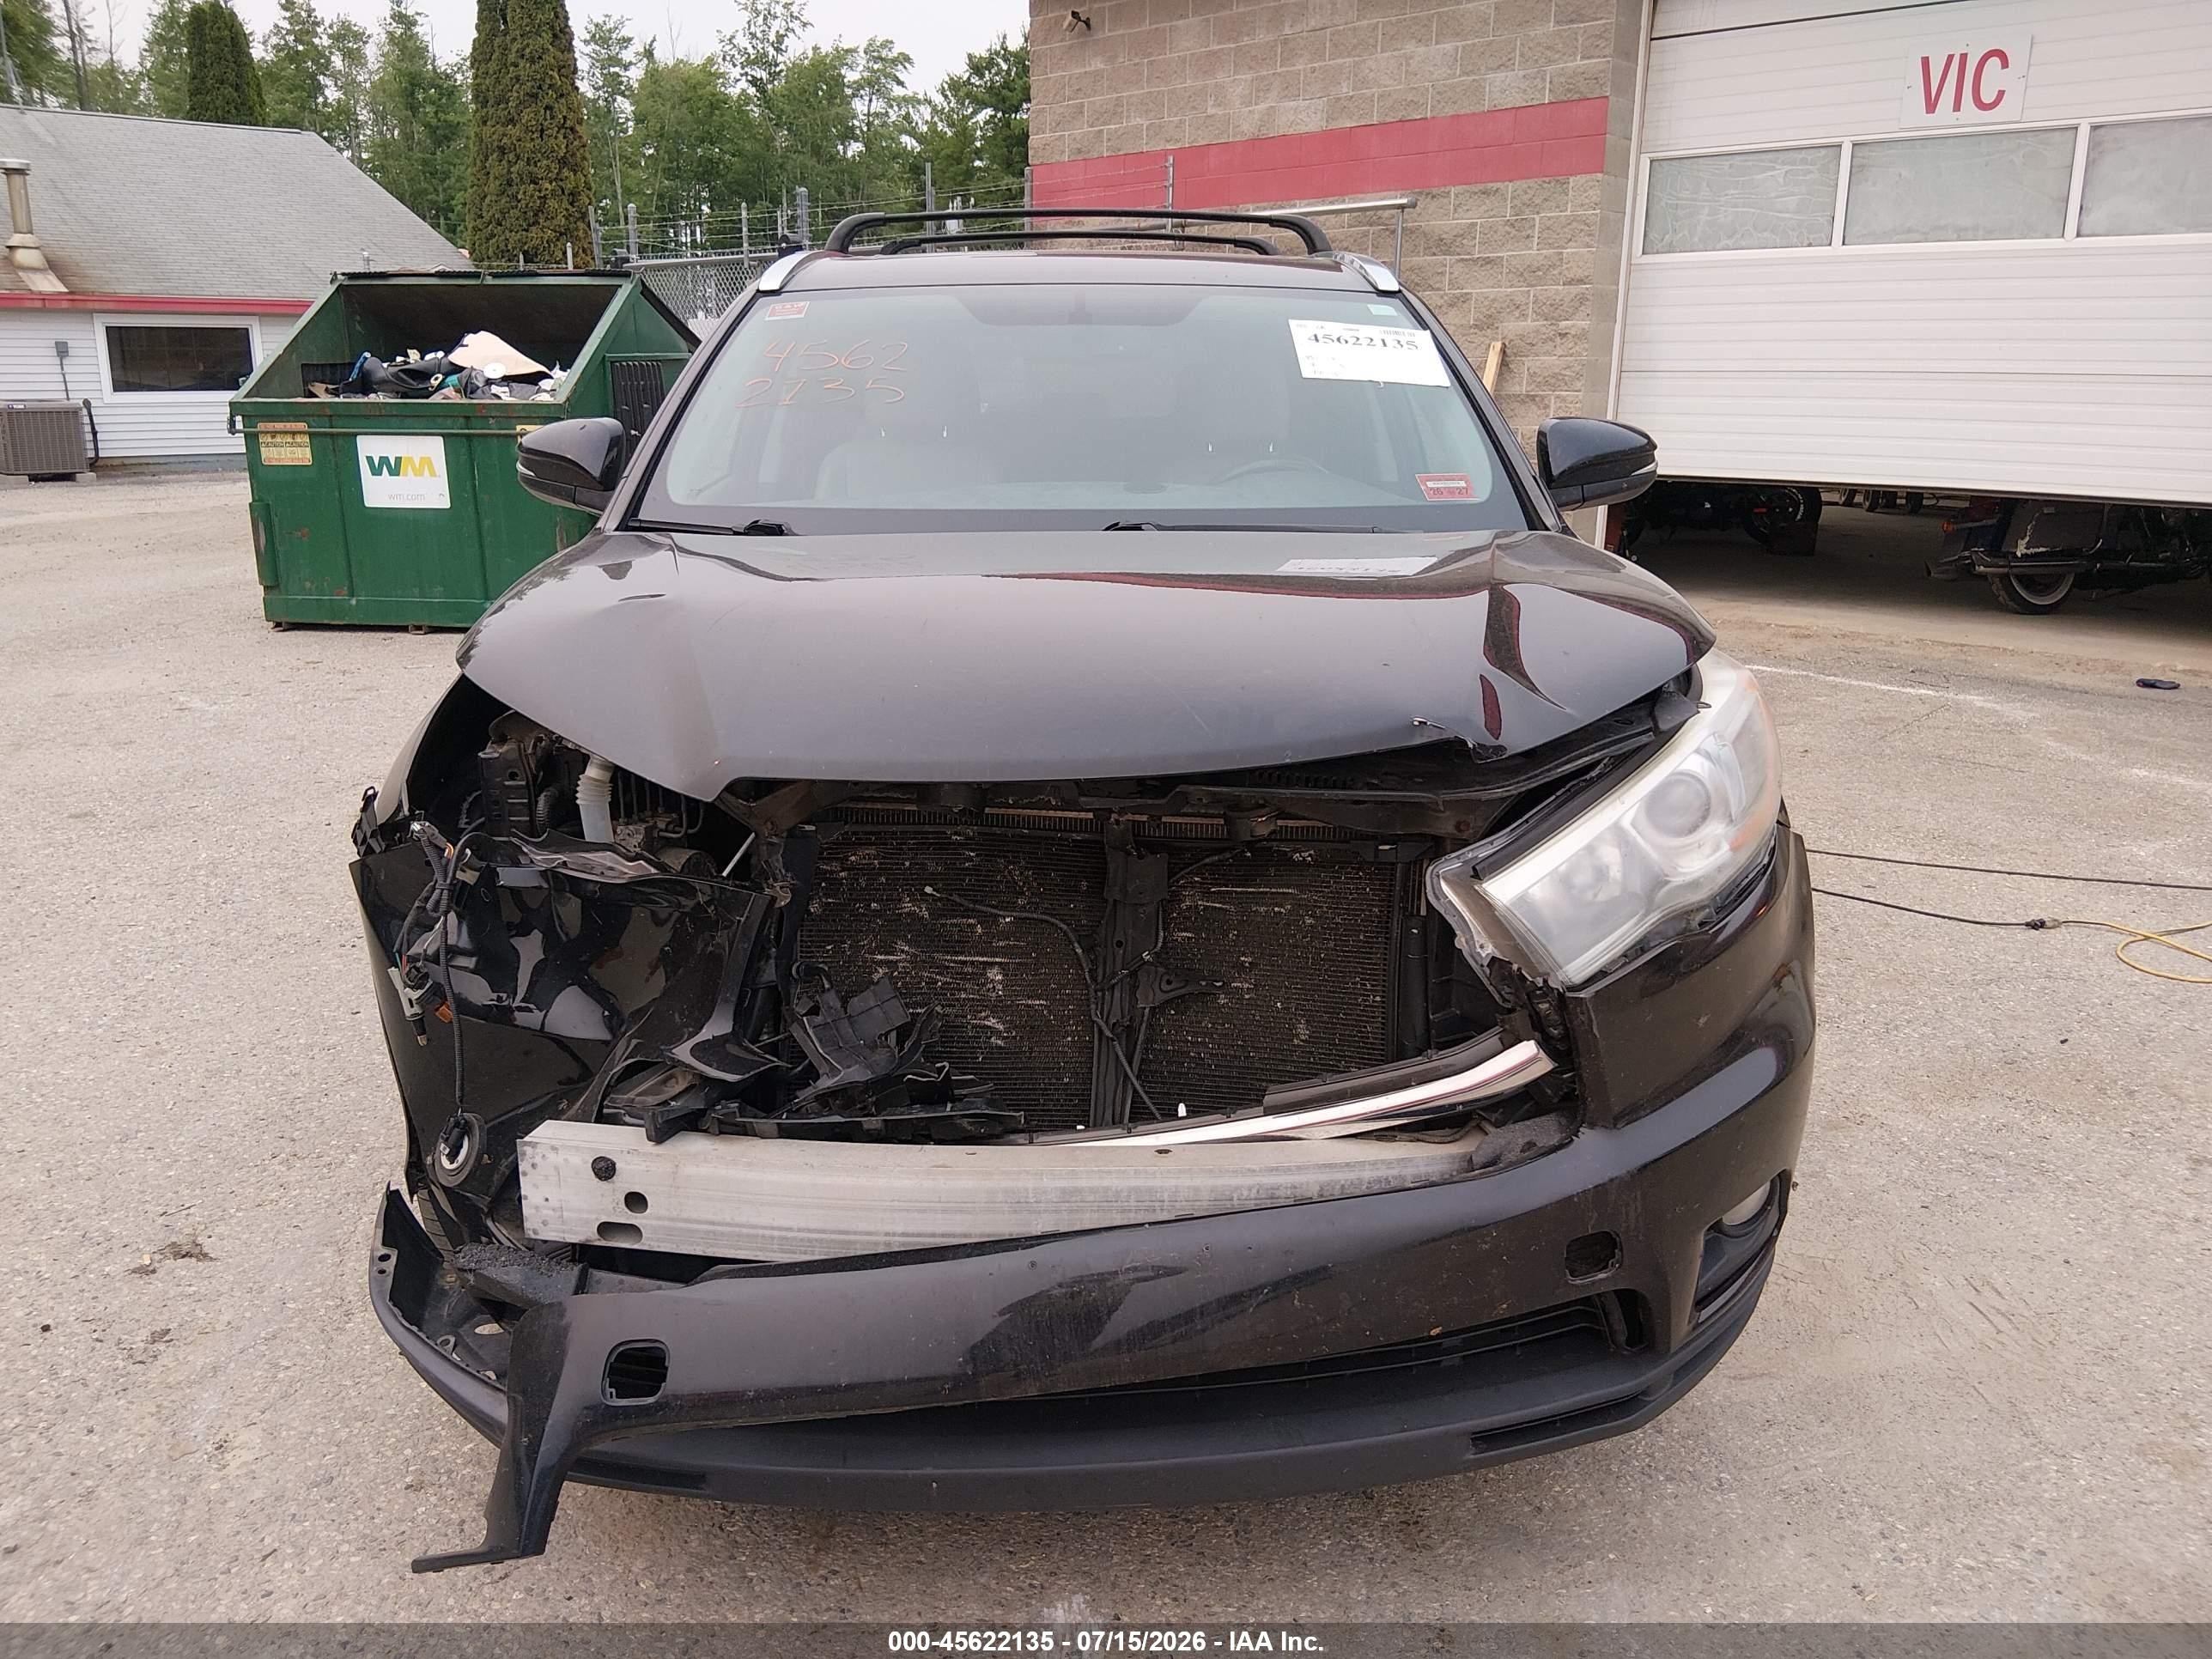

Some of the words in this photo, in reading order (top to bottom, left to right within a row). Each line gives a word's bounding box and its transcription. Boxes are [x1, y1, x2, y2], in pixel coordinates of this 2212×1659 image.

[1920, 48, 2009, 114] VIC
[1307, 332, 1419, 351] 45622135
[763, 338, 908, 372] 4562
[365, 455, 437, 477] WM
[388, 493, 425, 501] wm.com
